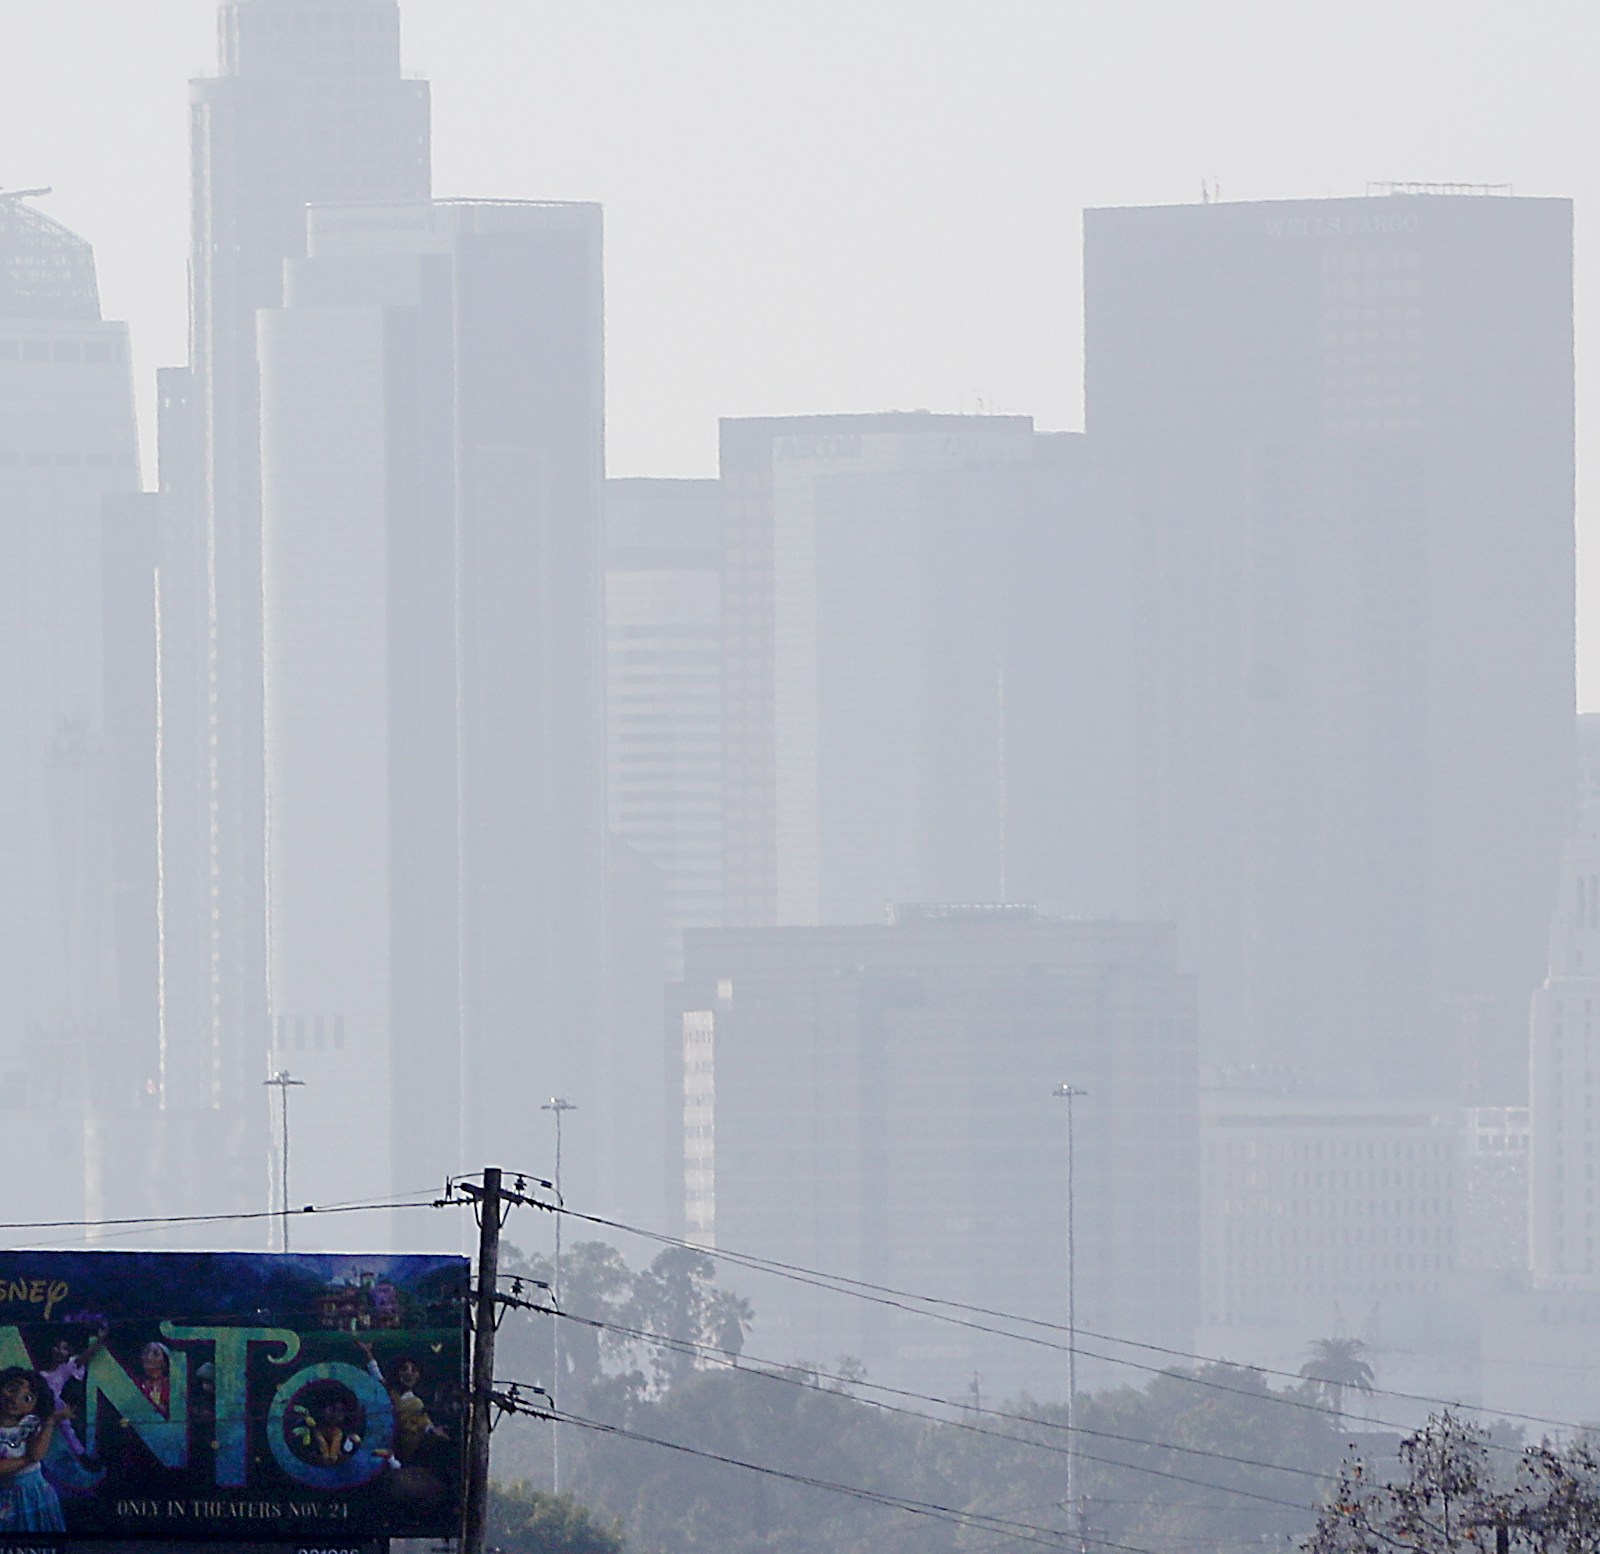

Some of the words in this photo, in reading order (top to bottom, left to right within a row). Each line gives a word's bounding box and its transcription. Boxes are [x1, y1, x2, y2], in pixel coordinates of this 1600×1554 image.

[116, 1499, 160, 1518] ONLY
[165, 1499, 187, 1518] IN
[192, 1499, 283, 1519] THEATERS
